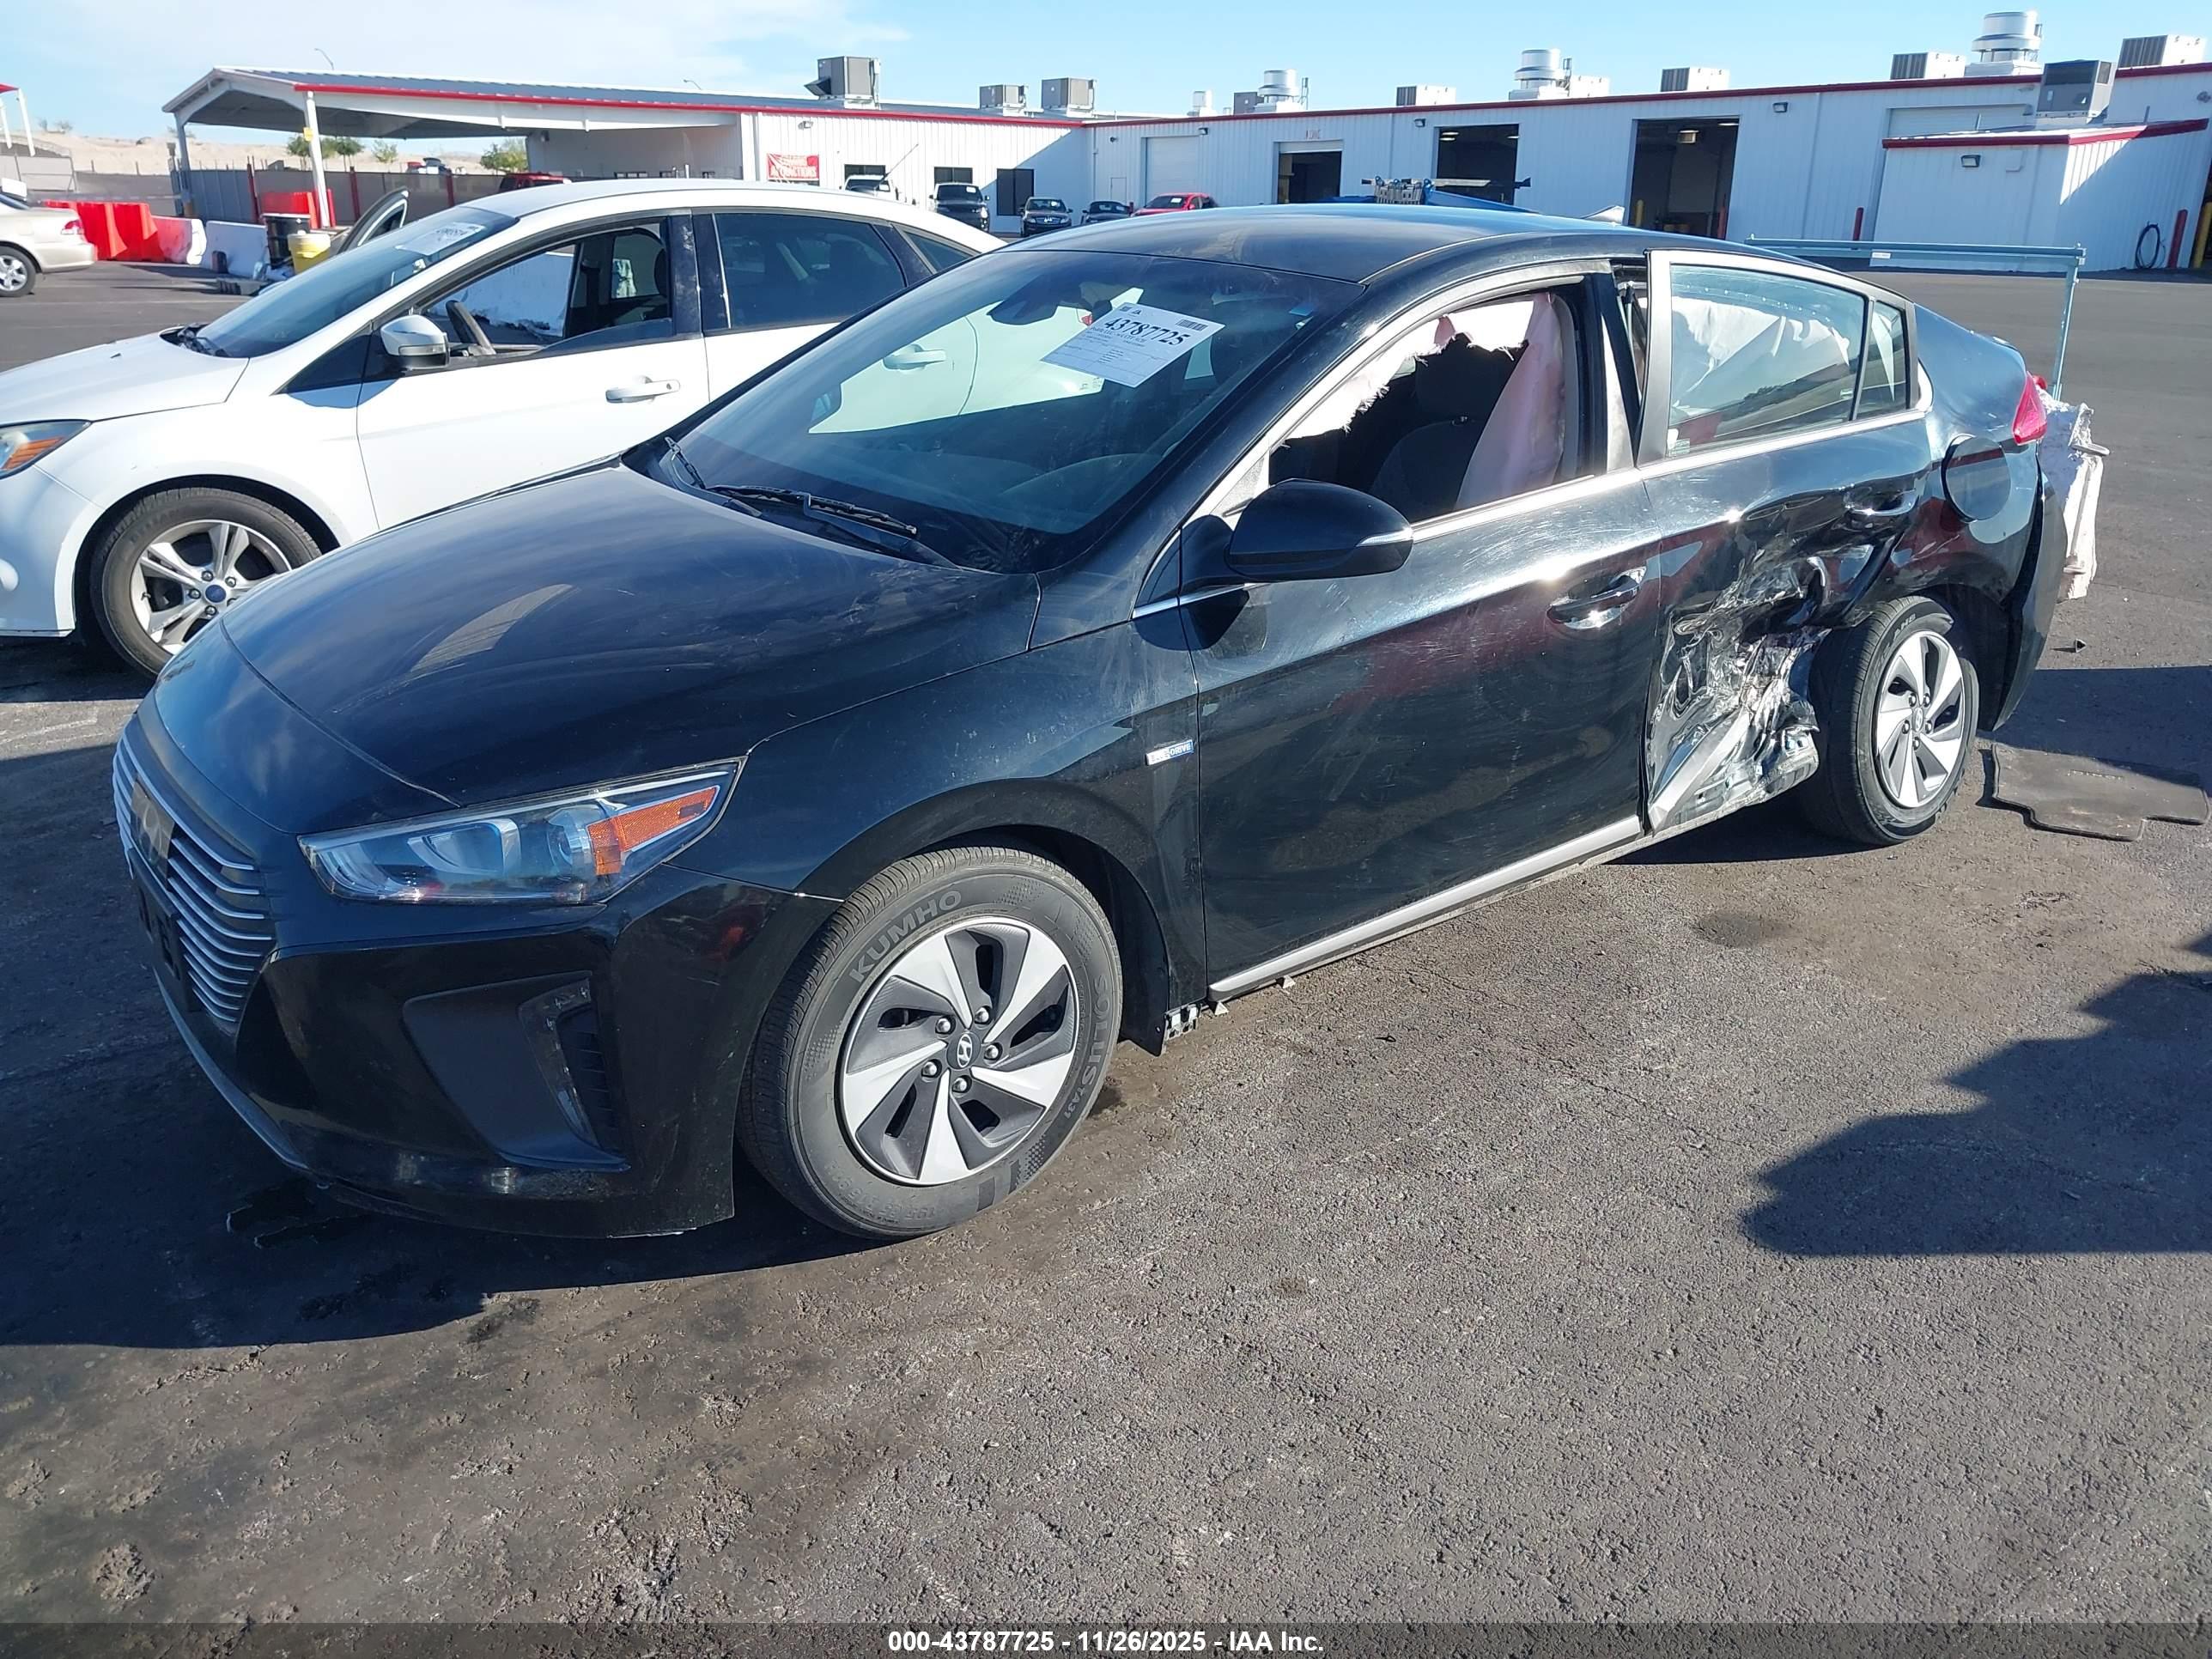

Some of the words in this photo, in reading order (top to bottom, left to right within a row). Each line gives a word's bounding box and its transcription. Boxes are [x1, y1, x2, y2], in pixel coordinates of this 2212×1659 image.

[1105, 317, 1191, 345] 43787725
[1170, 742, 1191, 756] DRIVE
[849, 890, 962, 982] KUMHO
[1081, 975, 1110, 1085] SOLUS
[1064, 1085, 1085, 1119] TA31
